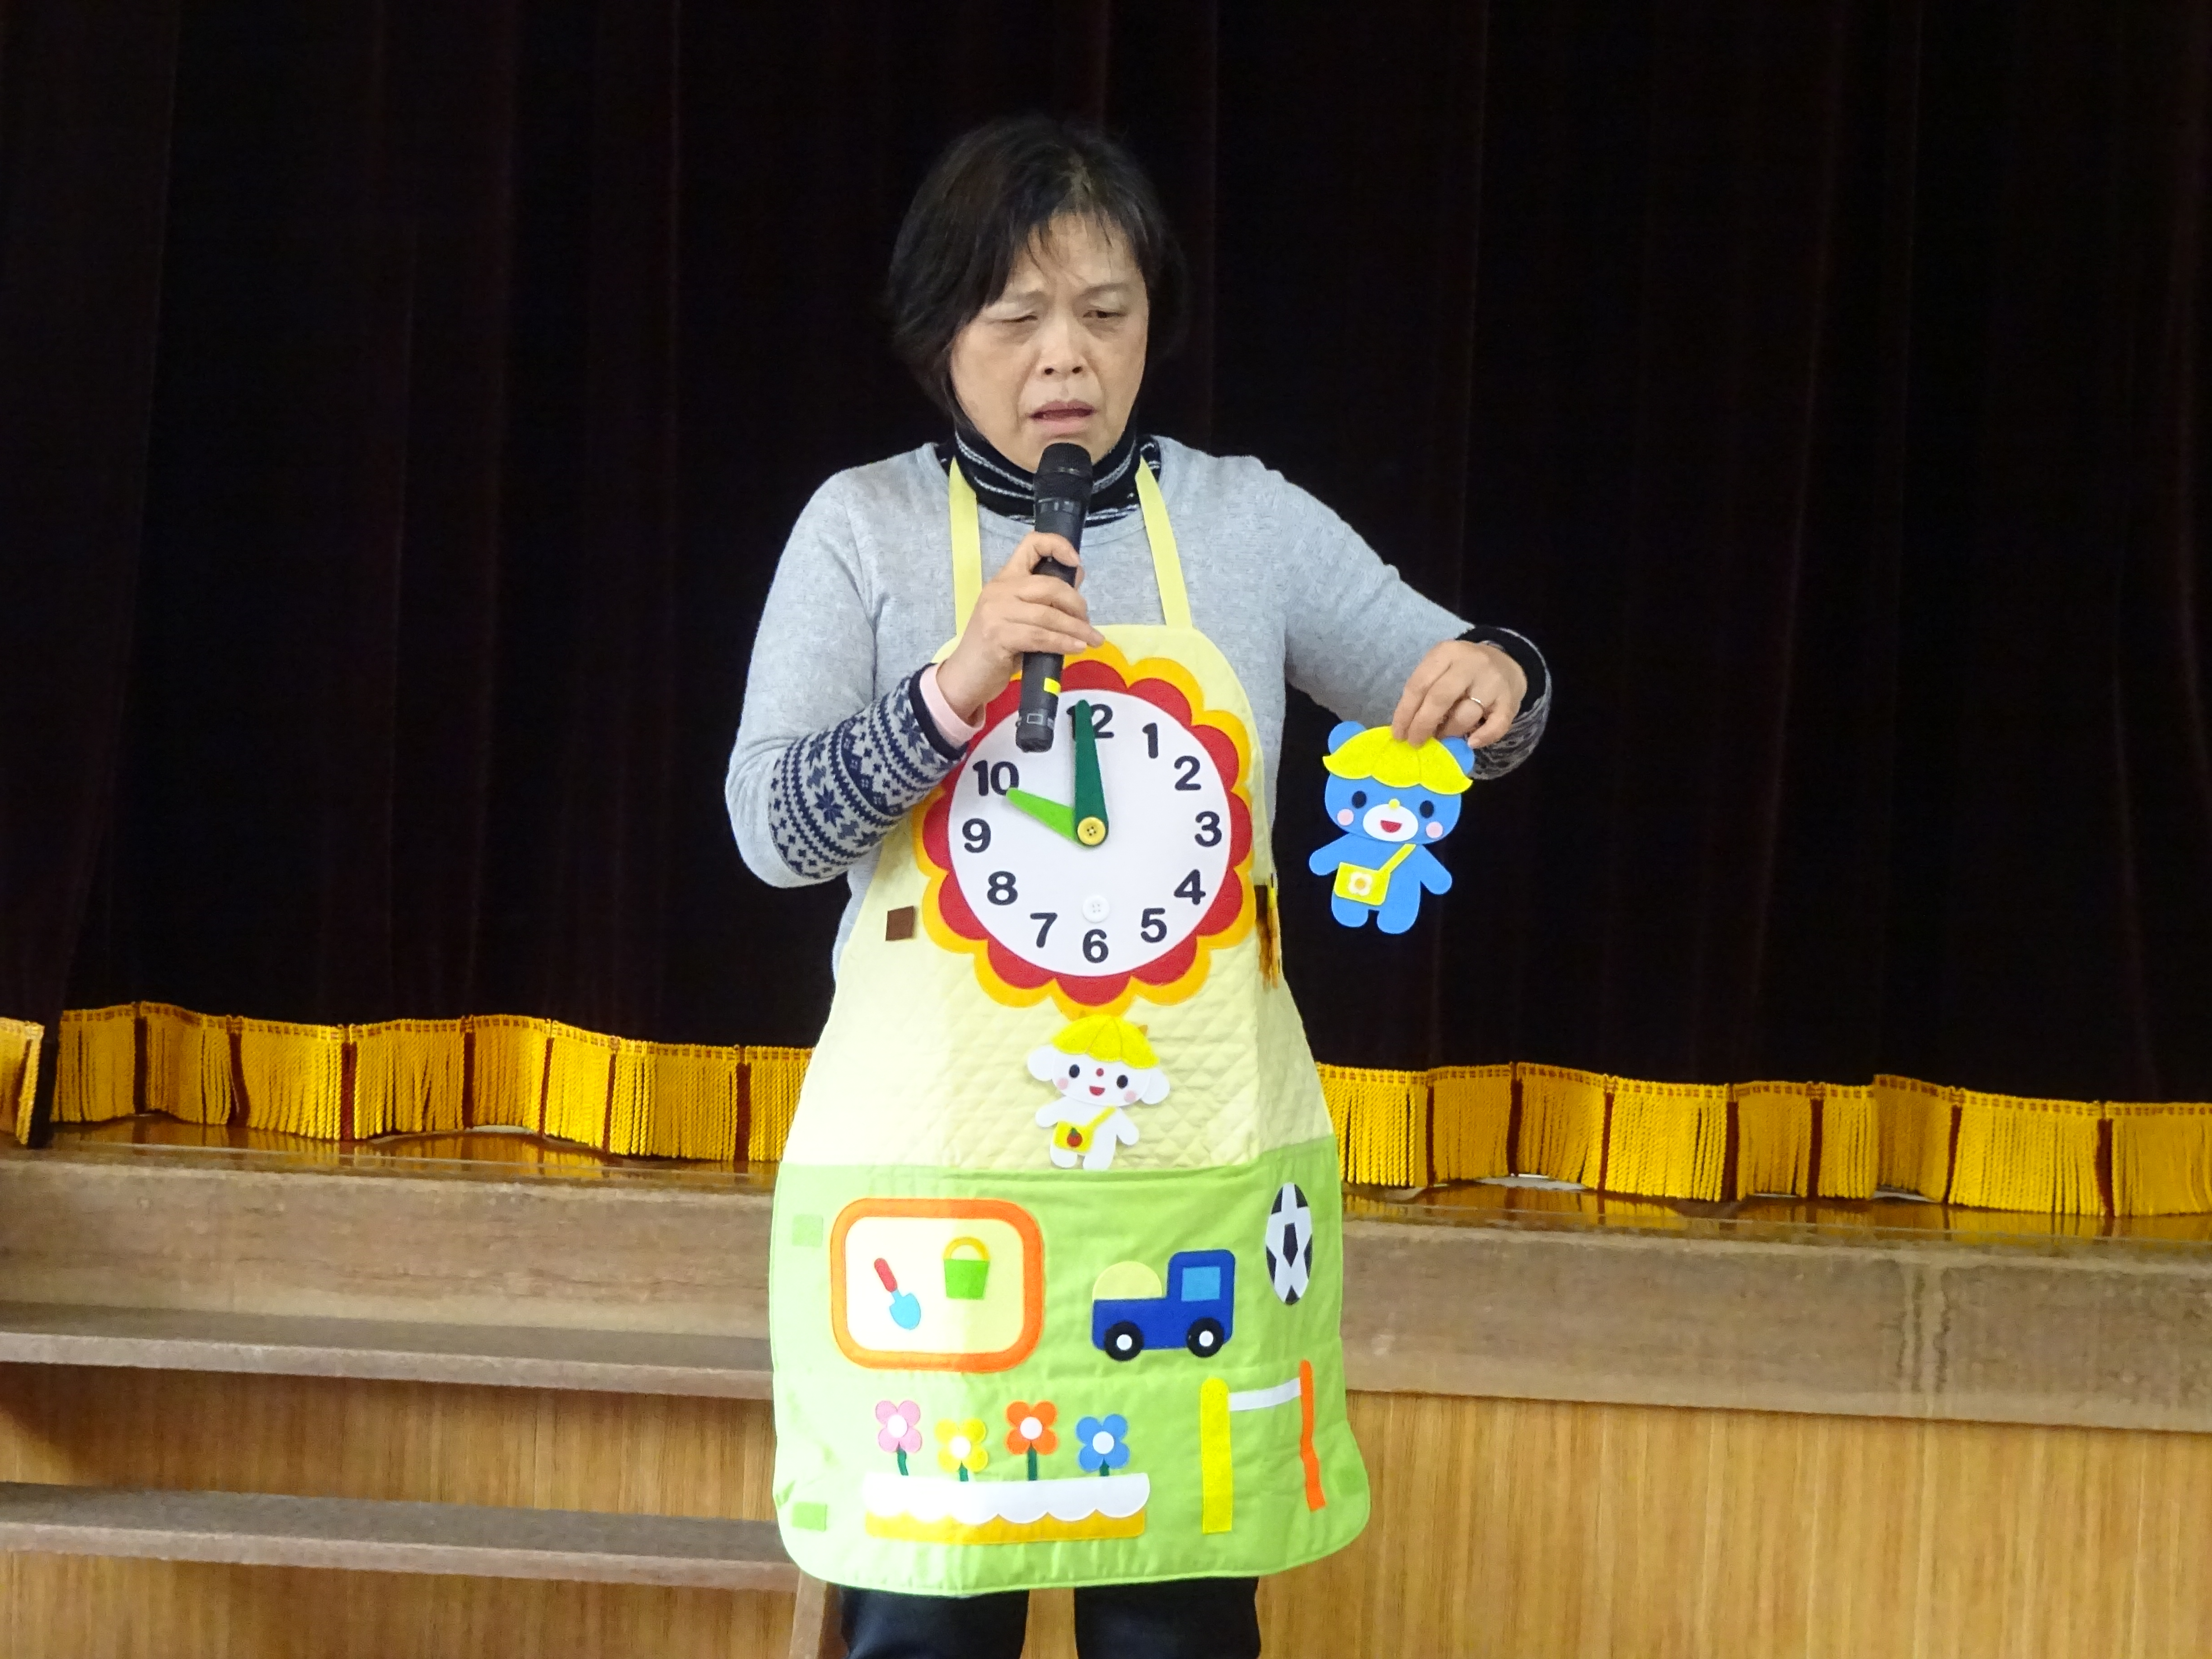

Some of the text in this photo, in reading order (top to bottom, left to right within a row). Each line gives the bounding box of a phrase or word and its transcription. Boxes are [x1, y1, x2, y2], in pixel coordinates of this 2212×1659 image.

[1142, 723, 1159, 759] 1
[972, 759, 1019, 796] 10
[1174, 755, 1202, 791] 2
[962, 818, 991, 853] 9
[1195, 811, 1222, 847] 3
[987, 871, 1018, 905] 8
[1174, 869, 1206, 905] 4
[1030, 913, 1058, 947] 7
[1141, 908, 1167, 943] 5
[1083, 929, 1109, 963] 6
